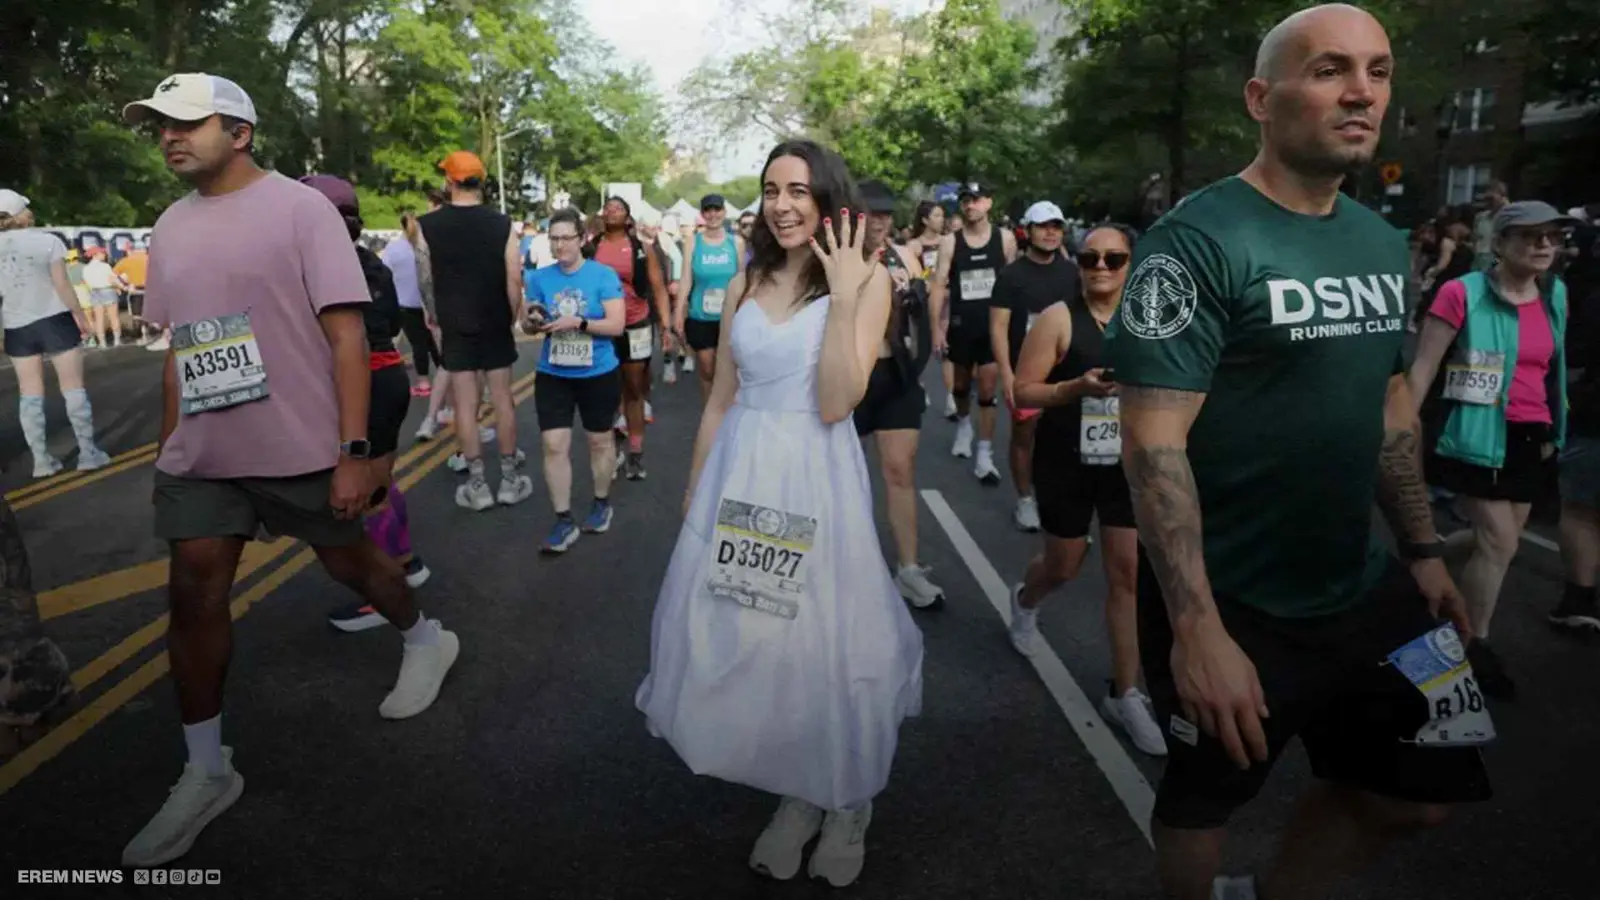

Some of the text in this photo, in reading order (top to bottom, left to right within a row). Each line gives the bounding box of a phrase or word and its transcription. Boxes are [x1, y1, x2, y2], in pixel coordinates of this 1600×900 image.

[1266, 273, 1406, 325] DSNY
[1289, 318, 1402, 342] RUNNING CLUB
[184, 343, 254, 384] A33591
[717, 539, 804, 579] D35027
